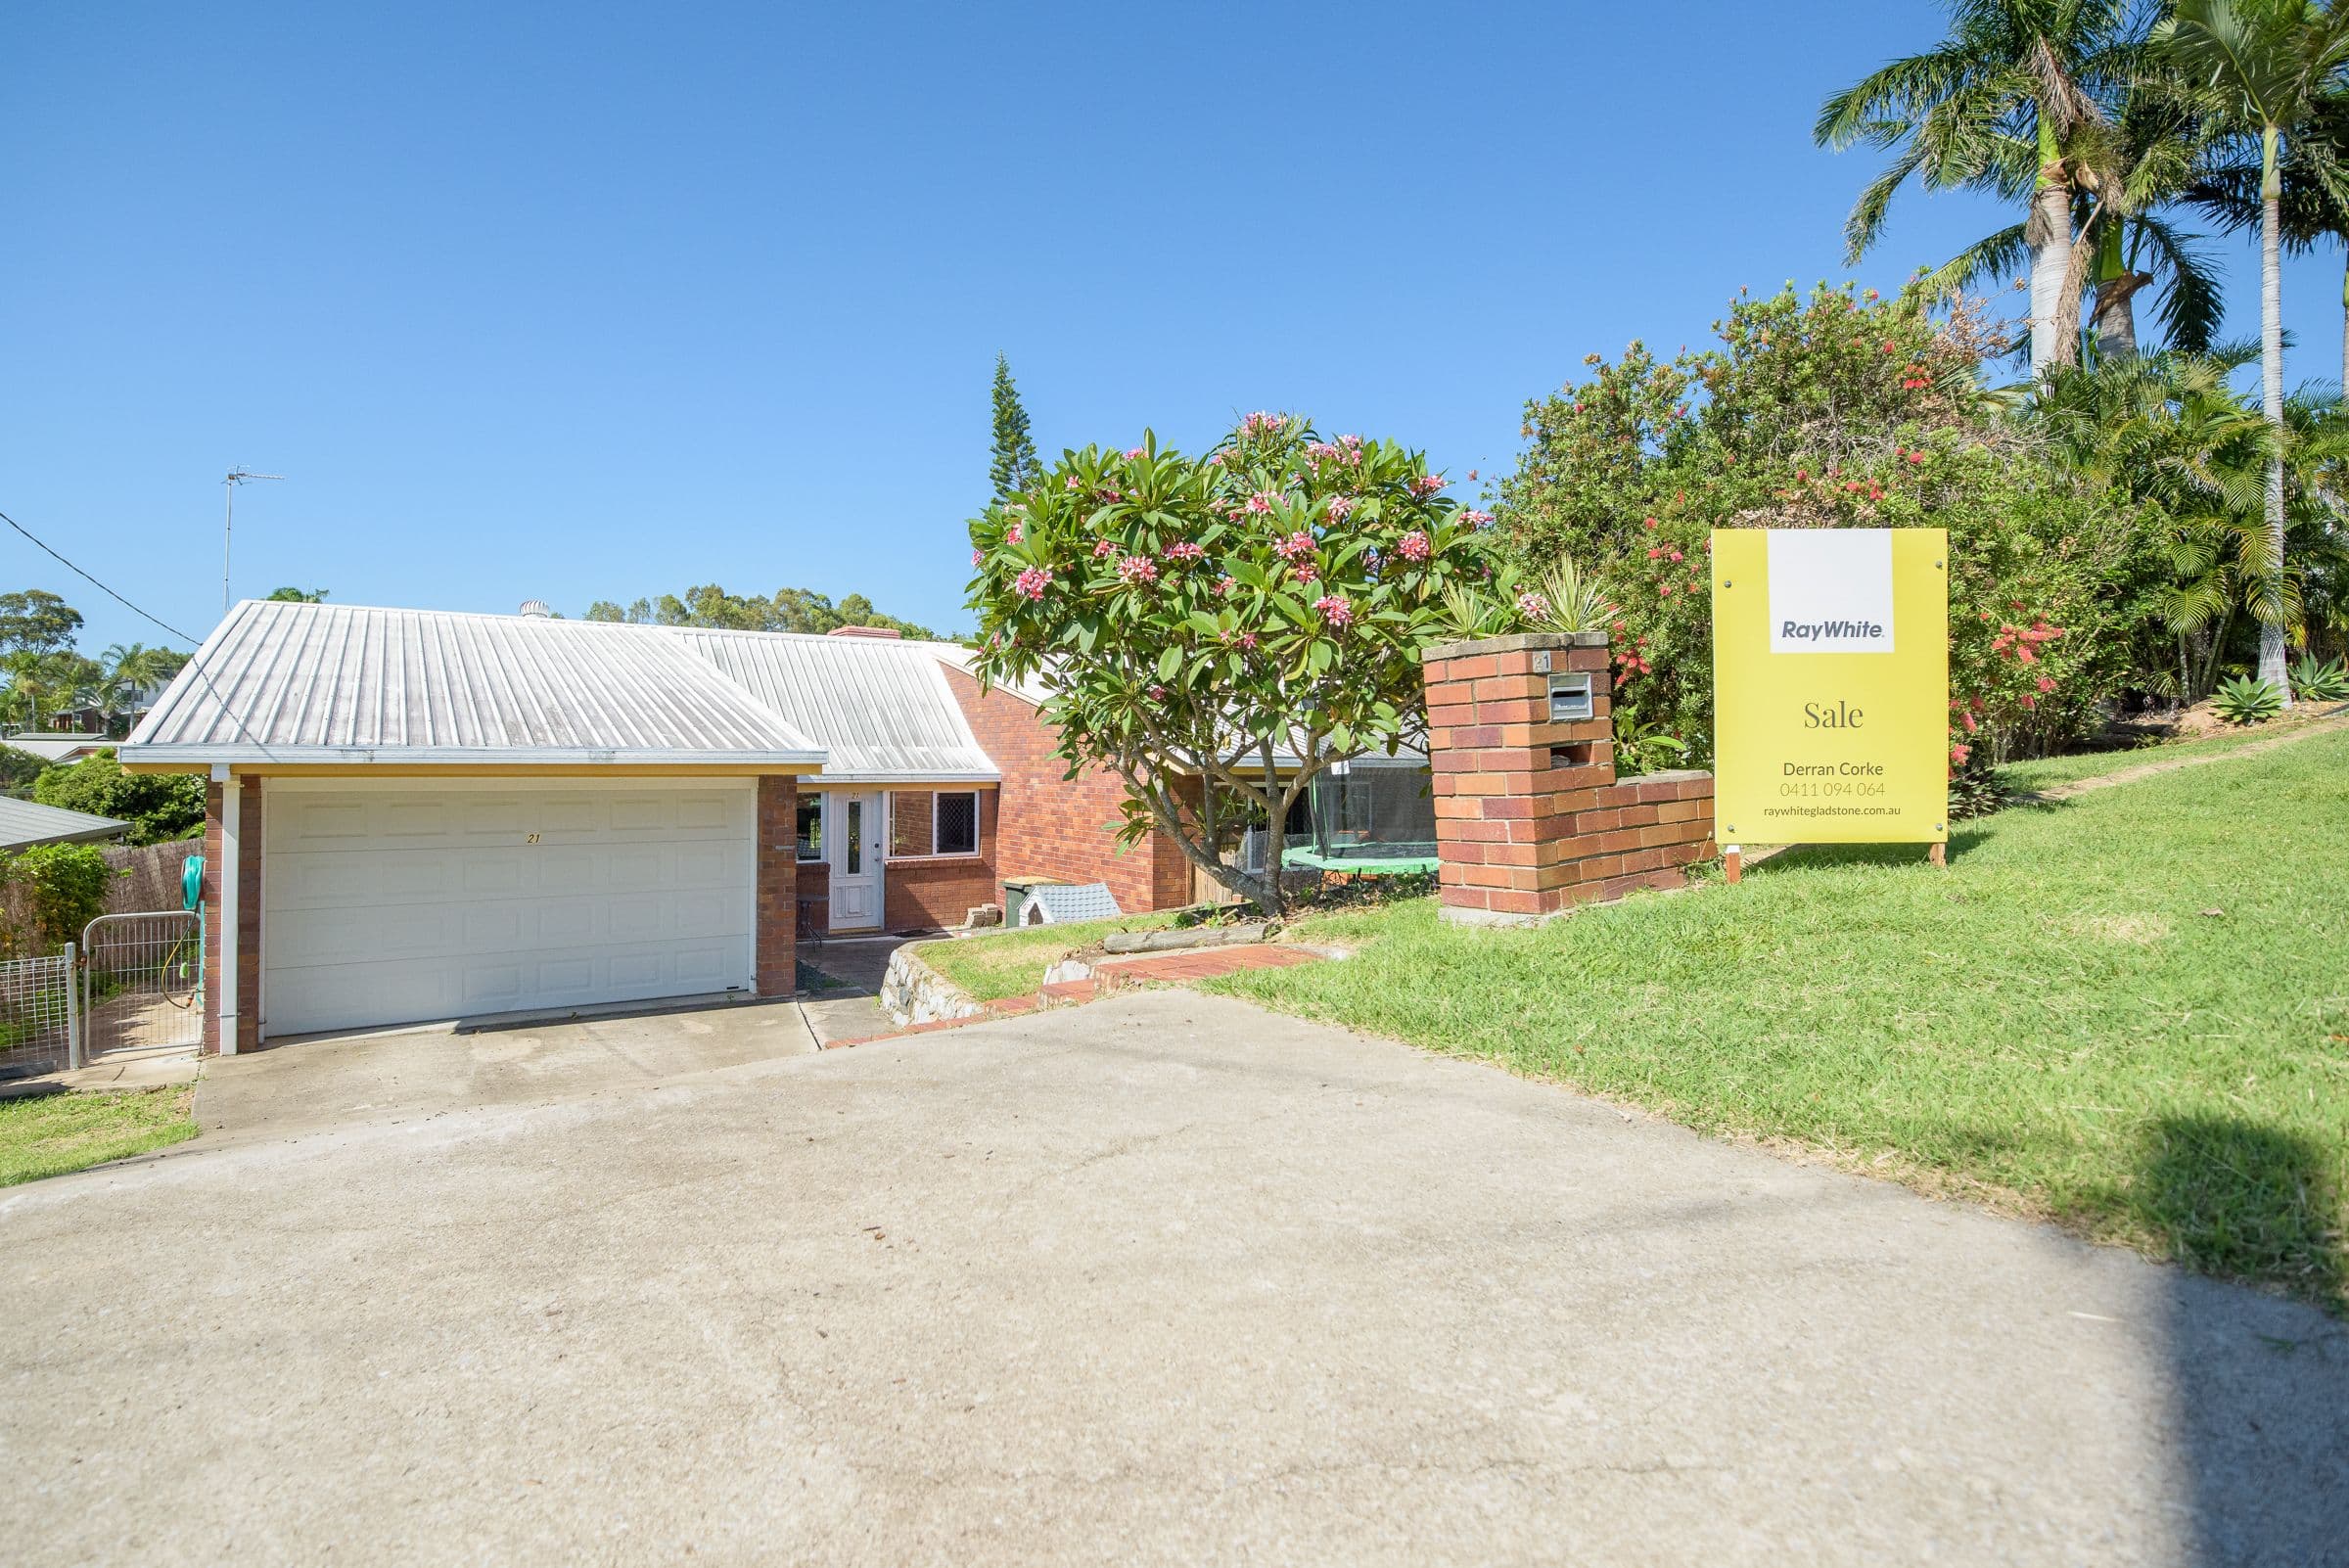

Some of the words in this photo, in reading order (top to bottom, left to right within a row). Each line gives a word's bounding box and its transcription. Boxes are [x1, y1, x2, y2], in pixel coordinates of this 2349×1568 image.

[1804, 700, 1864, 728] Sale
[1783, 761, 1835, 776] Derran
[1839, 761, 1884, 776] Corke
[1780, 782, 1819, 797] 0411
[1822, 782, 1853, 797] 094
[1857, 782, 1886, 797] 064
[1764, 805, 1901, 817] raywhitegladstone.com.au
[528, 833, 540, 844] 21
